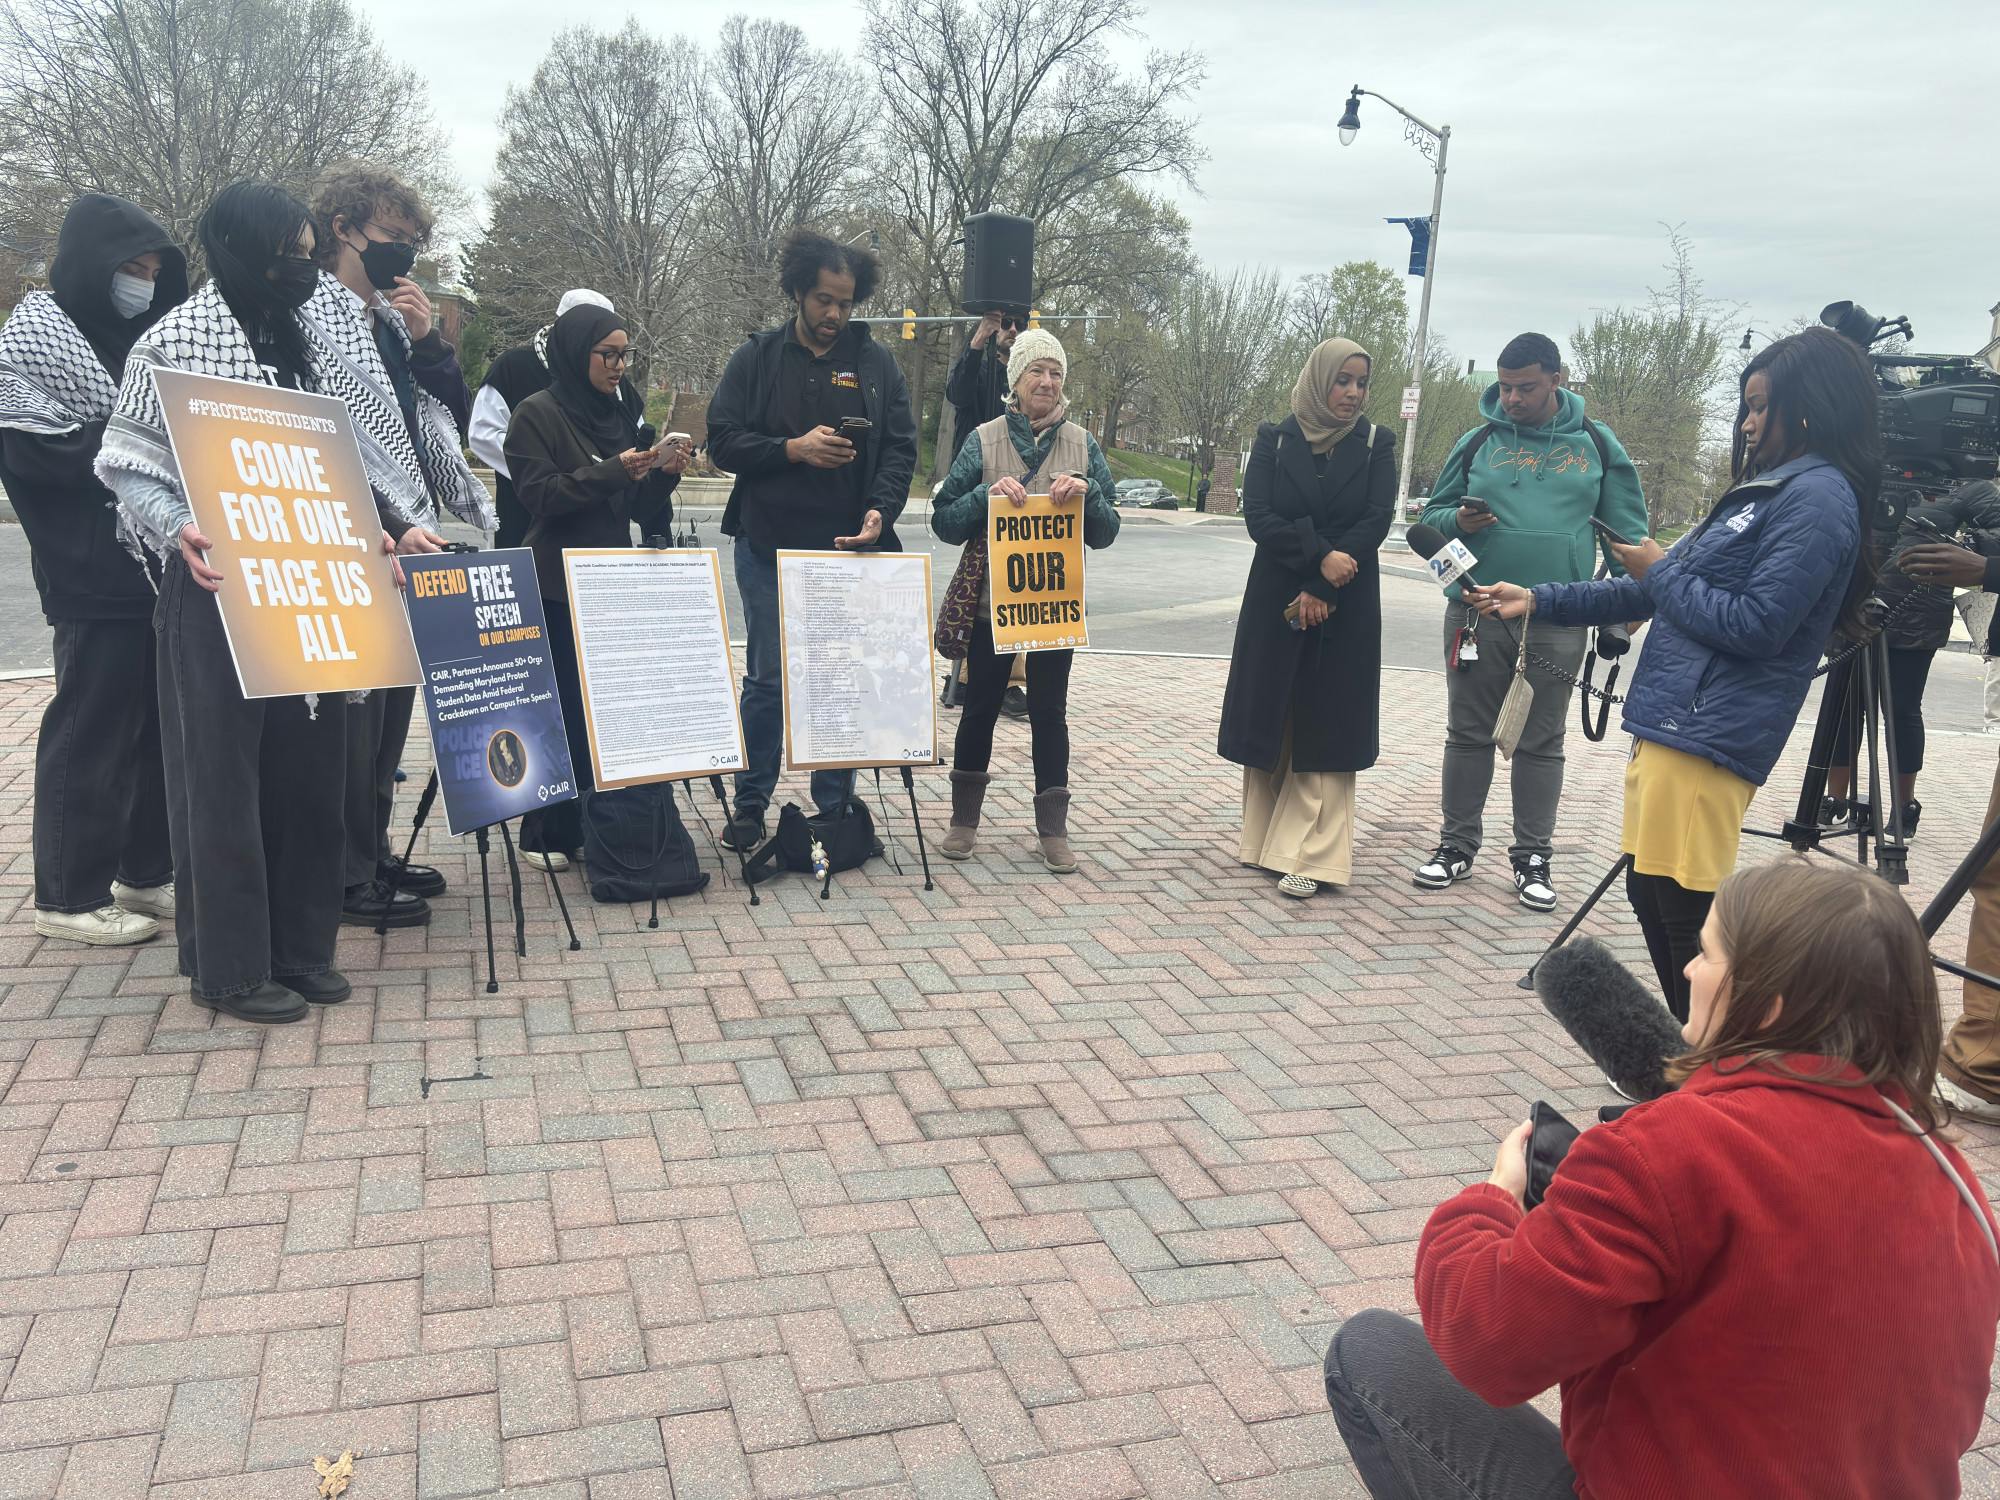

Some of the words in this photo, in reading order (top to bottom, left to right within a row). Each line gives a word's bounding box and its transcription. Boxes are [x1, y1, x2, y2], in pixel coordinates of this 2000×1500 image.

[188, 398, 337, 434] #PROTECTSTUDENTS
[231, 437, 331, 493] COME
[219, 492, 292, 543] FOR
[293, 499, 368, 552] ONE,
[996, 514, 1074, 541] PROTECT
[1450, 544, 1464, 560] 2
[1007, 552, 1065, 593] OUR
[1430, 559, 1448, 577] 2
[1440, 566, 1458, 582] WMAR
[240, 558, 327, 607] FACE
[327, 561, 372, 606] US
[412, 569, 468, 598] DEFEND
[468, 564, 515, 602] FREE
[475, 602, 522, 629] SPEECH
[997, 600, 1080, 627] STUDENTS
[296, 615, 357, 662] ALL
[480, 632, 490, 646] ON
[491, 630, 505, 645] OUR
[505, 626, 540, 643] CAMPUSES
[431, 670, 452, 681] CAIR,
[452, 666, 482, 677] Partners
[482, 661, 514, 672] Announce
[528, 656, 543, 666] Orgs
[434, 681, 474, 694] Demanding
[475, 675, 506, 687] Maryland
[507, 671, 529, 681] Protect
[436, 696, 464, 708] Student
[465, 692, 481, 702] Data
[483, 688, 500, 699] Amid
[501, 684, 524, 694] Federal
[439, 708, 479, 721] Crackdown
[489, 700, 516, 711] Campus
[517, 696, 530, 705] Free
[531, 690, 552, 702] Speech
[439, 724, 492, 752] POLICE
[456, 753, 482, 780] ICE
[720, 755, 738, 764] CAIR
[550, 781, 570, 795] CAIR
